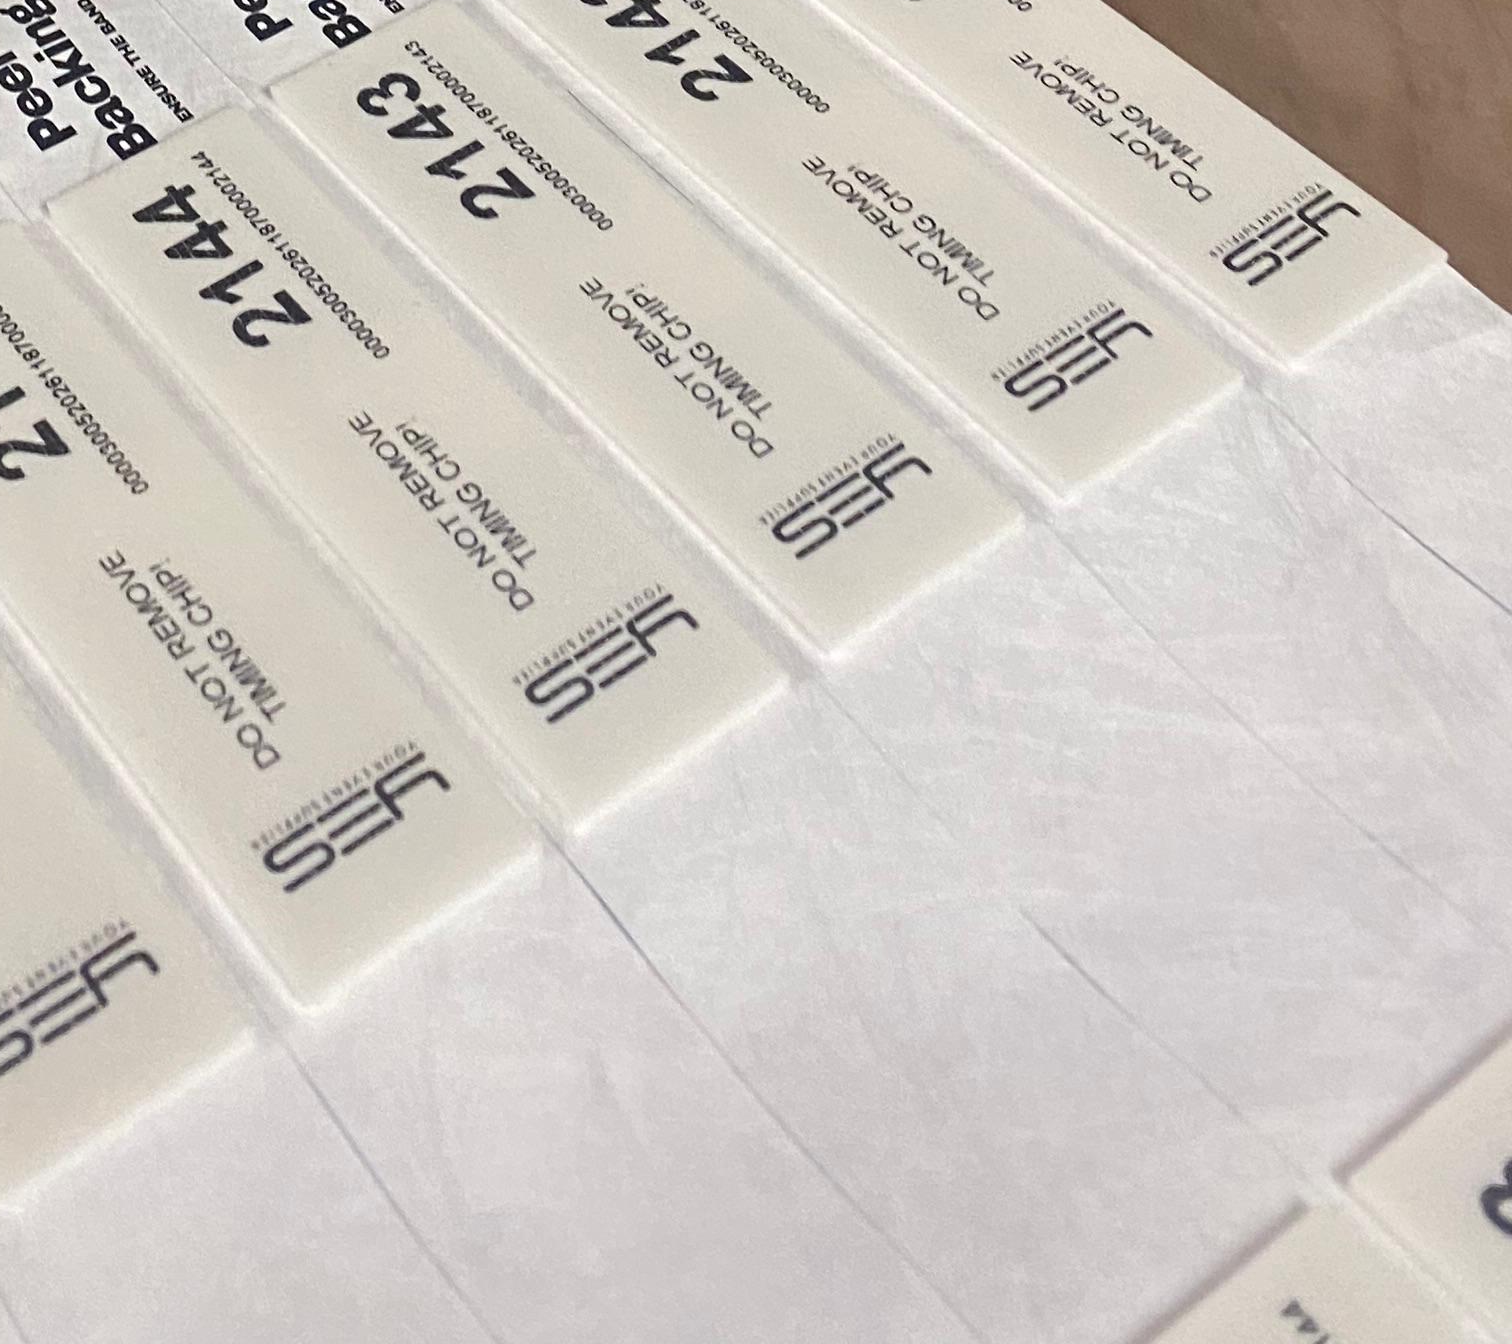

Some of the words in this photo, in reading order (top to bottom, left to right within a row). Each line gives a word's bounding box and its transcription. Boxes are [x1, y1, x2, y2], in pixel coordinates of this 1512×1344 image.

[1010, 51, 1112, 126] REMOVE
[357, 72, 535, 218] 2143
[1110, 130, 1168, 169] NOT
[1120, 104, 1202, 170] TIMING
[802, 156, 901, 237] REMOVE
[1170, 171, 1211, 201] DO
[132, 184, 311, 346] 2144
[899, 241, 958, 284] NOT
[912, 214, 993, 285] TIMING
[579, 278, 678, 367] REMOVE
[958, 286, 999, 319] DO
[673, 372, 732, 419] NOT
[689, 341, 771, 419] TIMING
[348, 411, 444, 510] REMOVE
[731, 420, 773, 457] DO
[437, 515, 495, 567] NOT
[456, 482, 535, 567] TIMING
[99, 550, 194, 659] REMOVE
[492, 569, 533, 610] DO
[184, 664, 242, 721] NOT
[207, 628, 285, 722] TIMING
[236, 723, 280, 768] DO
